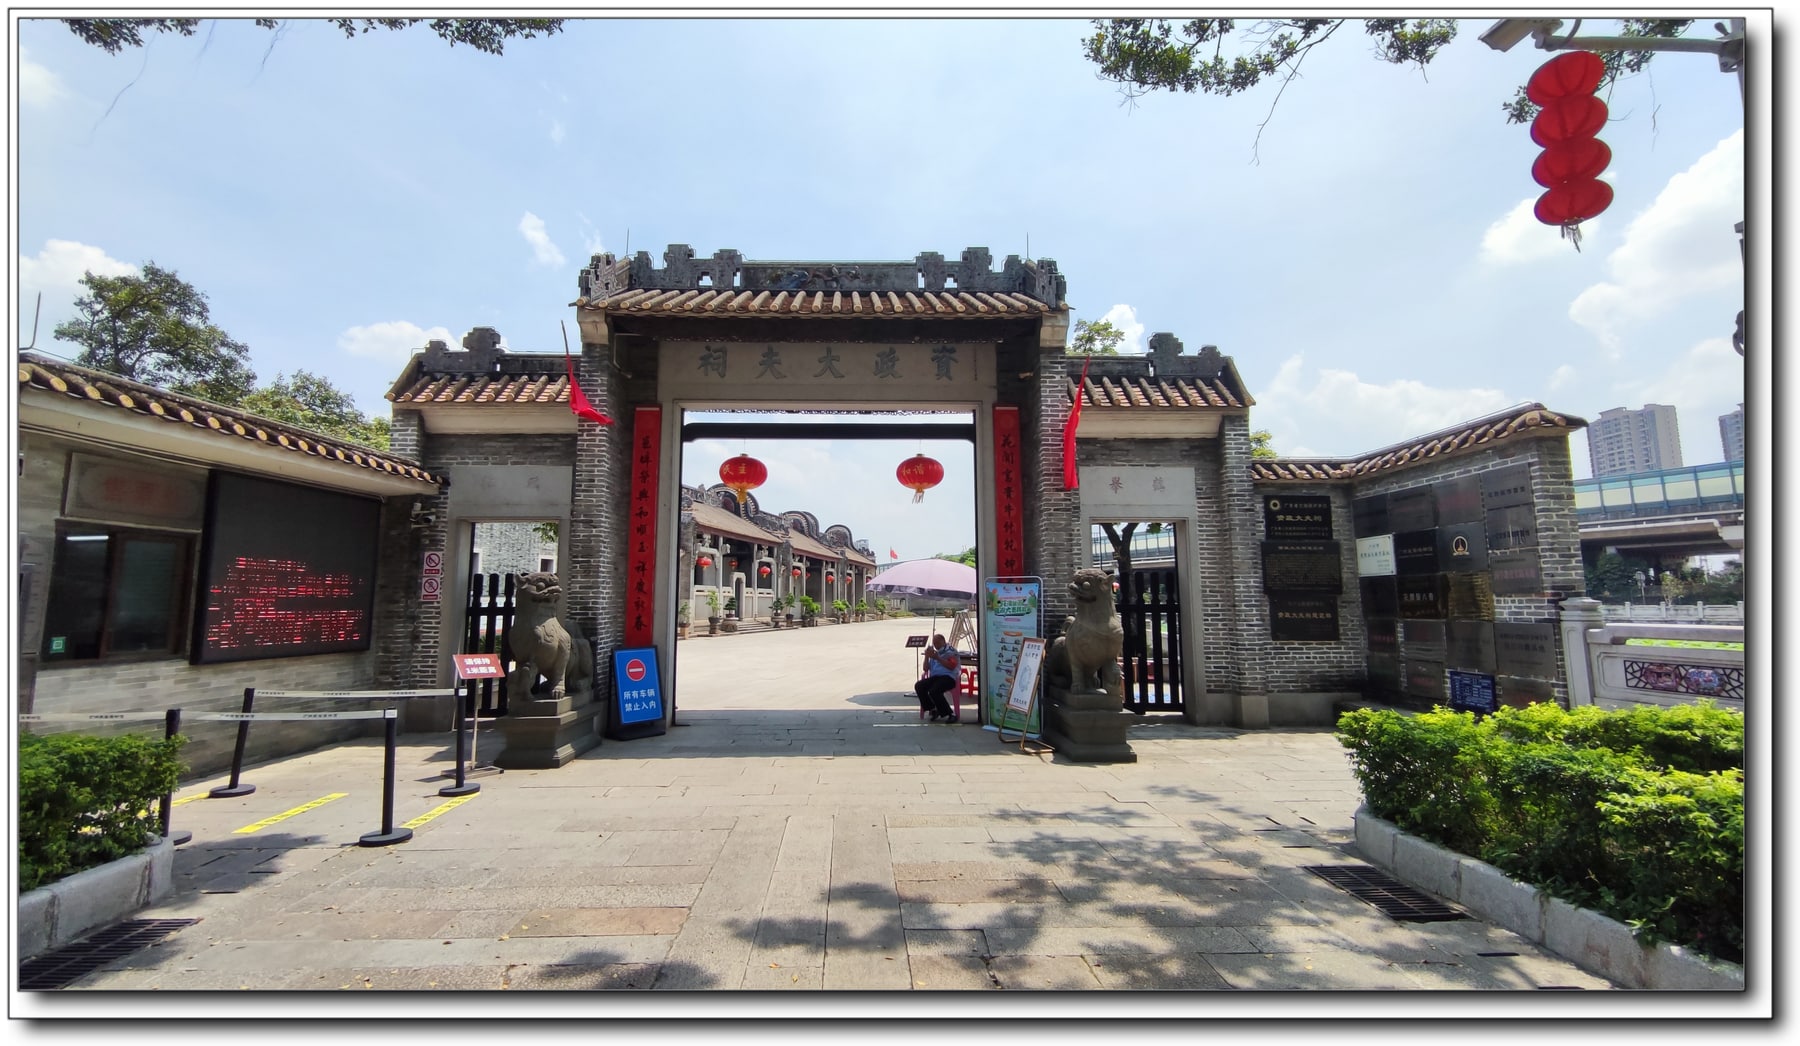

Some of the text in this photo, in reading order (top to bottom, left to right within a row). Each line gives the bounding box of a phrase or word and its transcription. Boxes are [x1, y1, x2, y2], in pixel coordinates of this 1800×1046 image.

[623, 688, 656, 700] 所有车辆
[624, 700, 657, 712] 禁止入内
